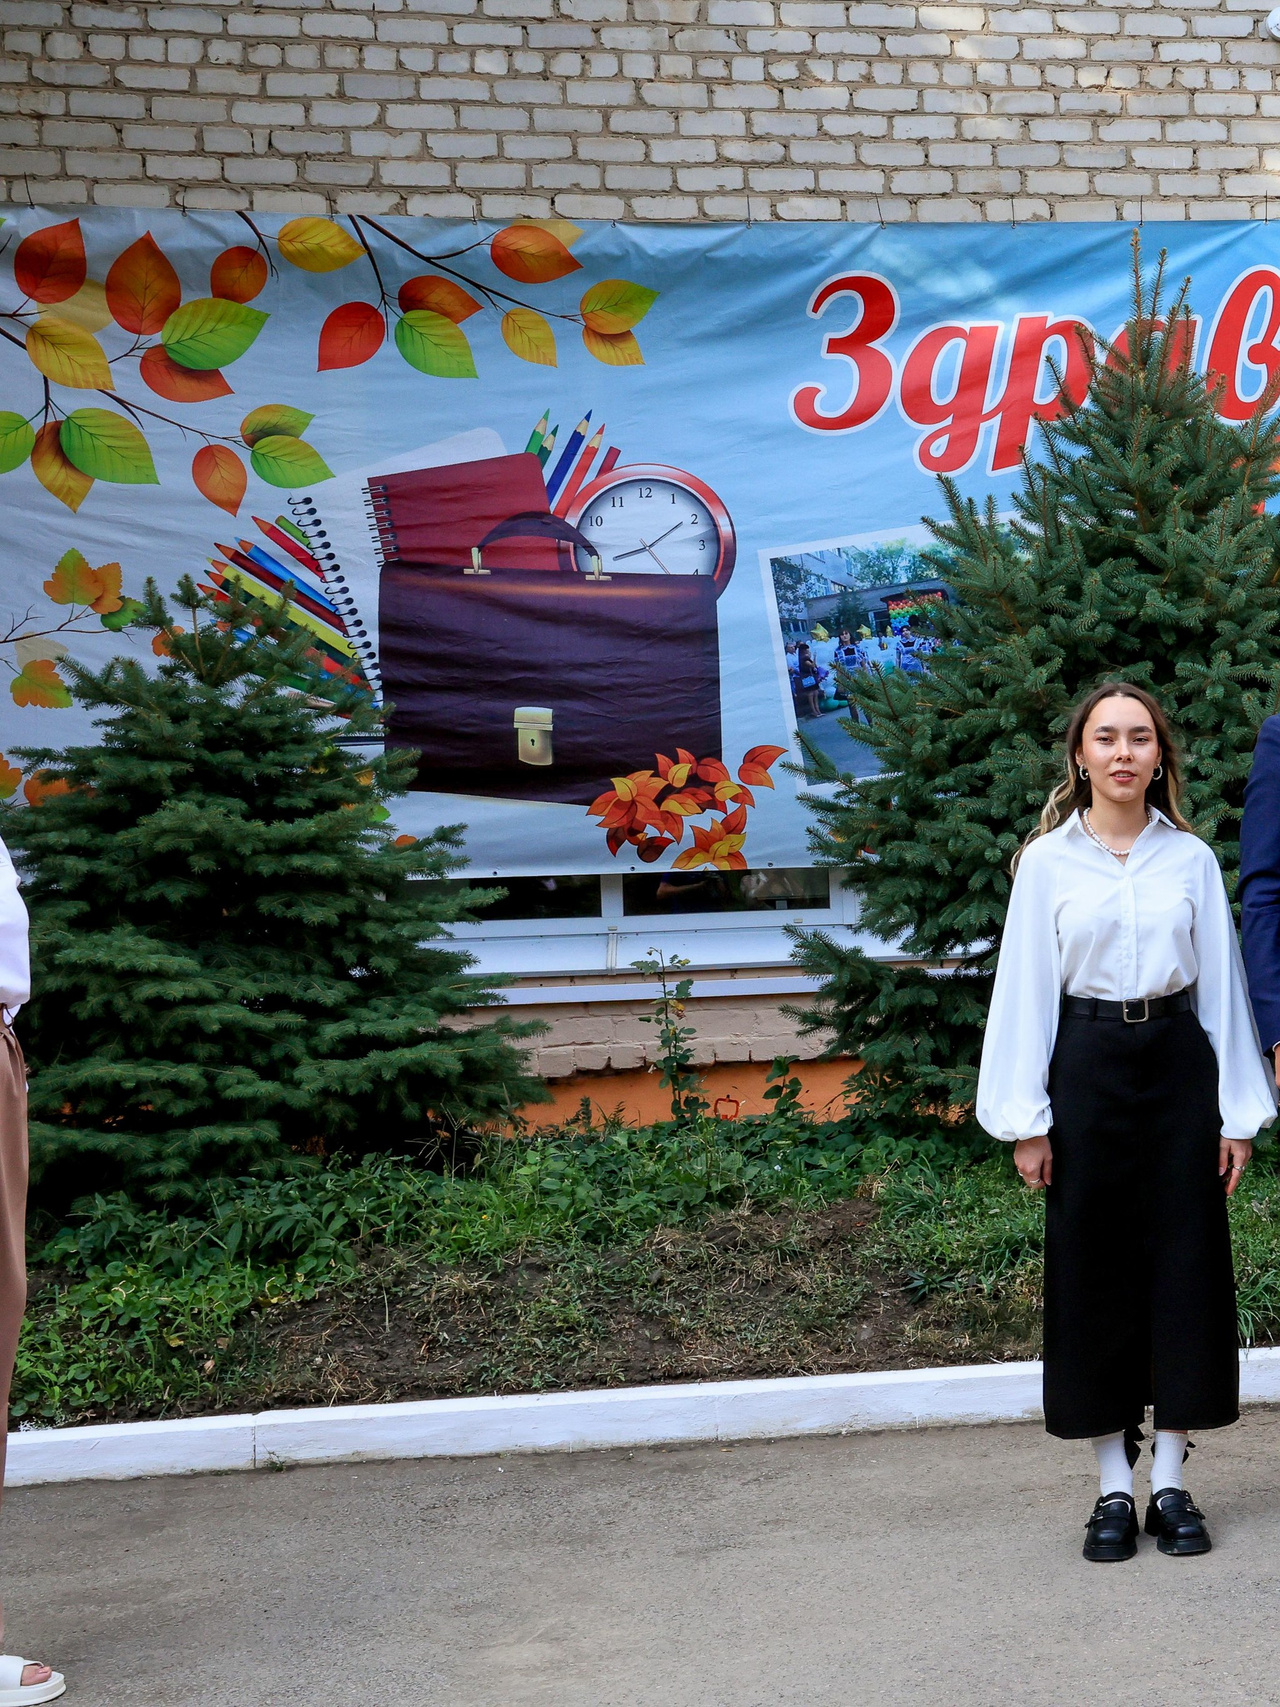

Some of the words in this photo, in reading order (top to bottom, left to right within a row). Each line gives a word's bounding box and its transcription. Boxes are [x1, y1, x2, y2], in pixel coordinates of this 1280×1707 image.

[638, 487, 653, 499] 12
[670, 493, 677, 505] 1
[611, 496, 624, 507] 11
[588, 515, 603, 527] 10
[690, 513, 698, 525] 2
[698, 539, 706, 551] 3
